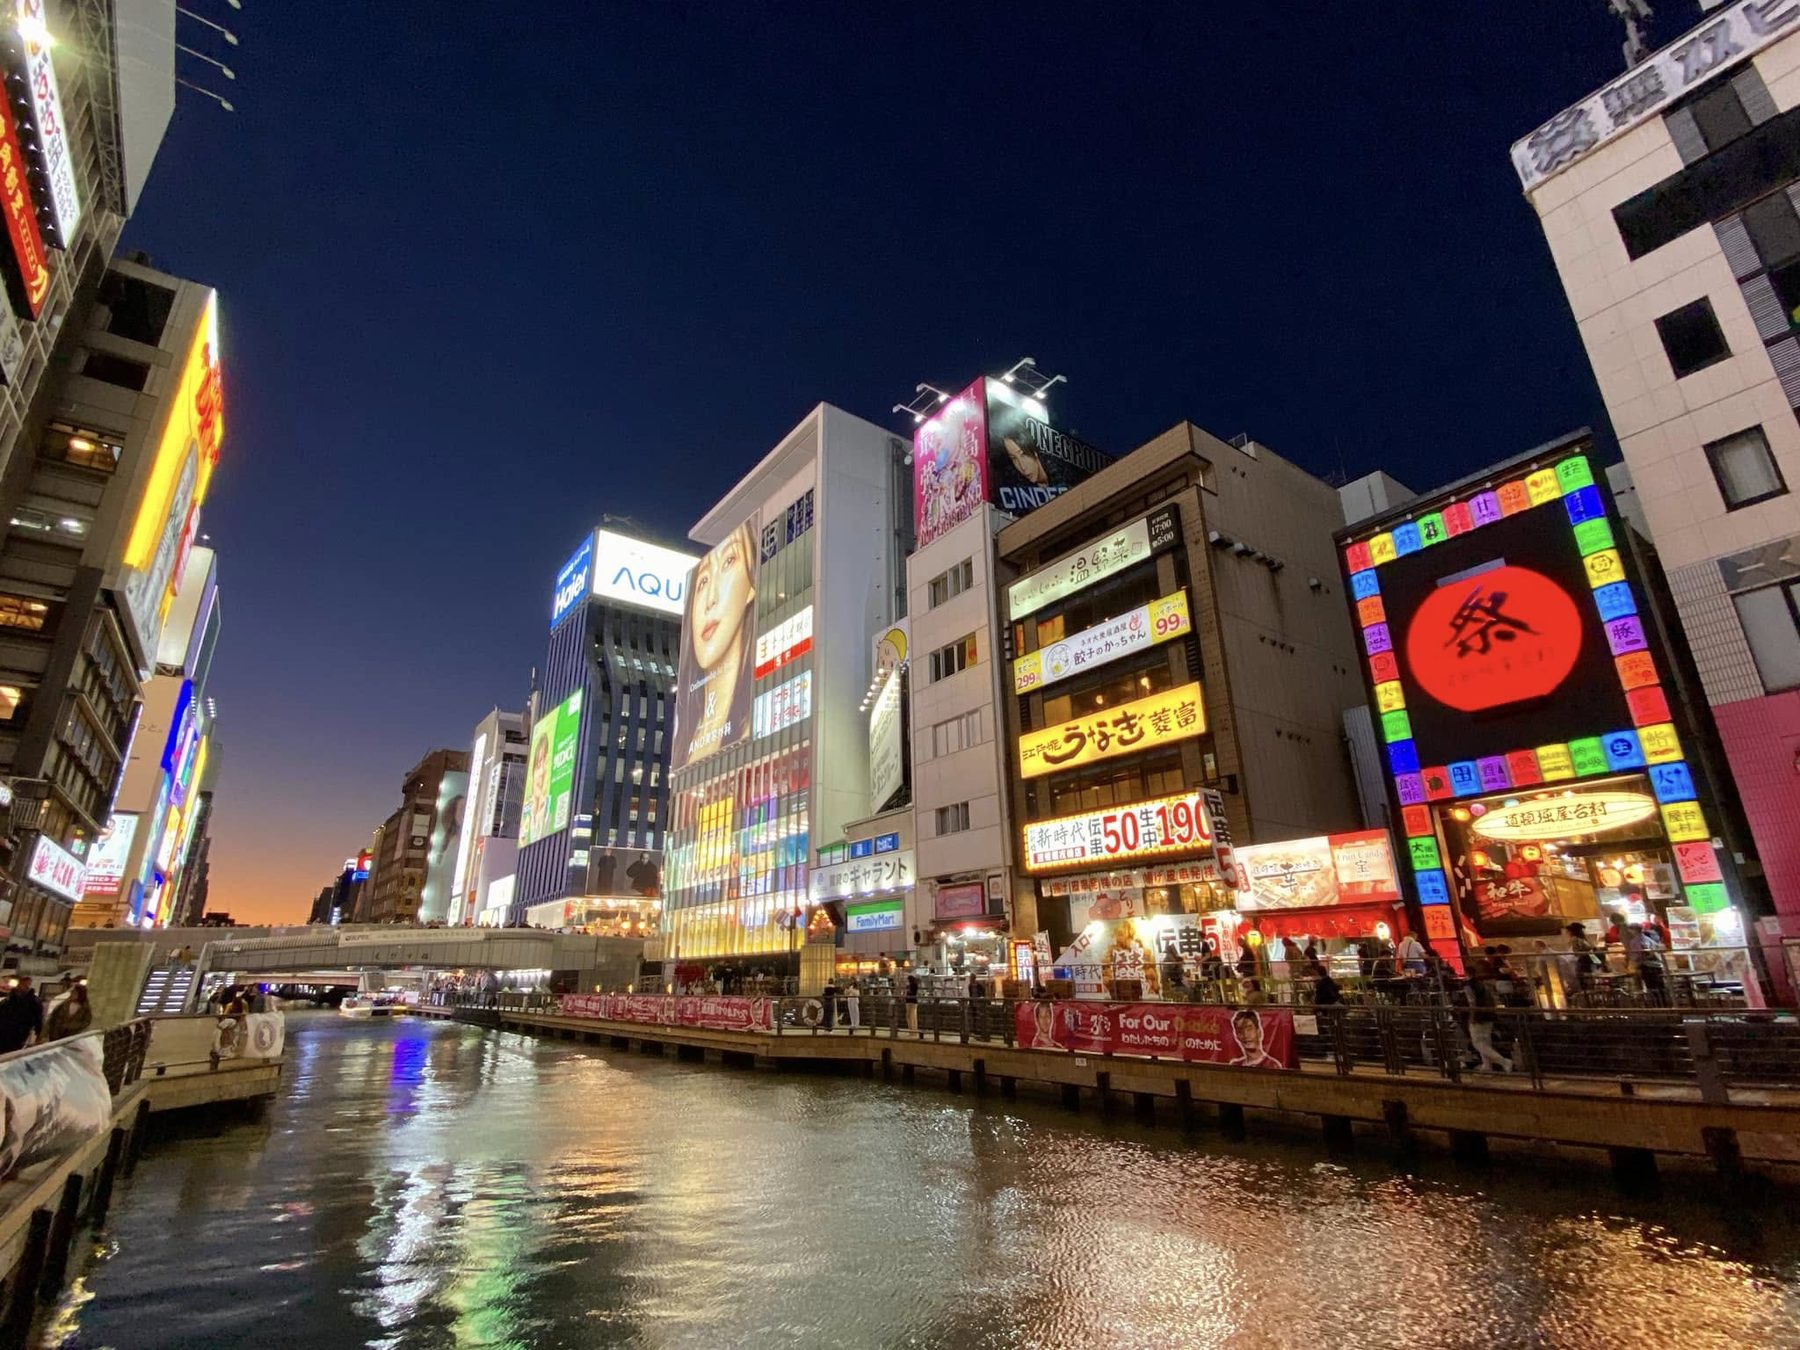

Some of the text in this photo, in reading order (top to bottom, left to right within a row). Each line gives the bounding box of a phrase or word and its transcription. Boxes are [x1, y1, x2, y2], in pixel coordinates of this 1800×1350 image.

[553, 564, 588, 619] Haier
[1073, 630, 1147, 665] 餃子のかっちゃん
[1505, 801, 1608, 828] 道頓堀屋台村
[1036, 821, 1086, 848] 新時代
[1103, 811, 1140, 854] 50
[1487, 880, 1531, 901] 和牛
[855, 914, 895, 928] FamilyMart
[1118, 1013, 1141, 1028] For
[1143, 1015, 1170, 1031] Our
